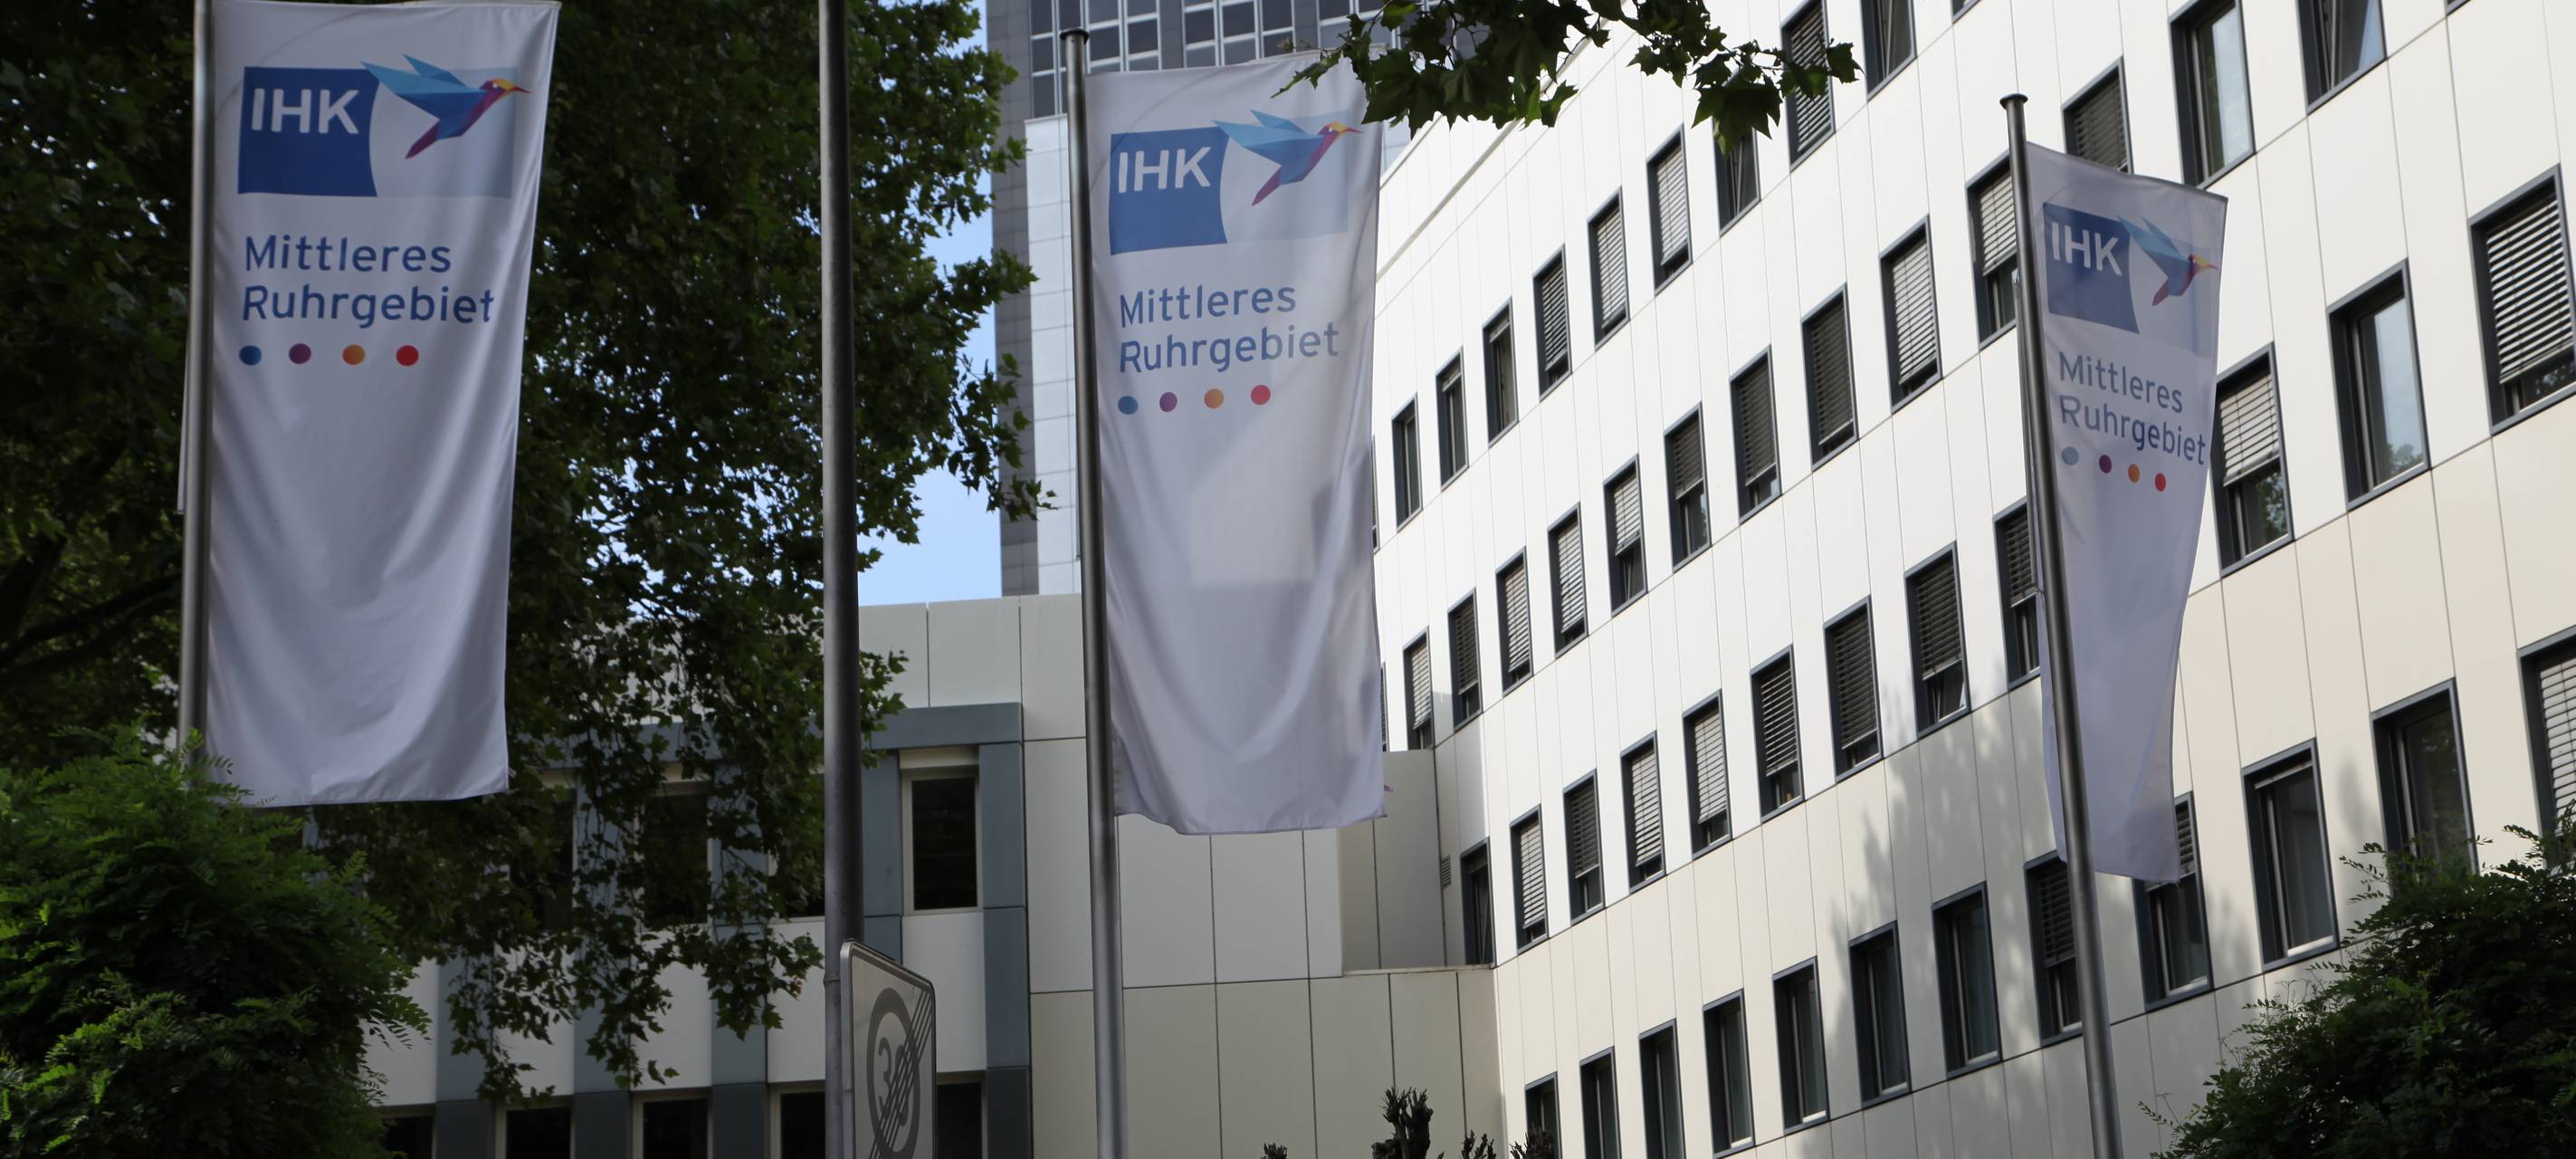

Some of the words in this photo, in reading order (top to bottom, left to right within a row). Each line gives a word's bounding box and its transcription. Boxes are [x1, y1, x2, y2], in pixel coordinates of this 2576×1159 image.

[251, 88, 359, 135] IHK
[1118, 146, 1211, 194] IHK
[244, 235, 452, 273] Mittleres
[2051, 221, 2123, 276] IHK
[242, 283, 495, 329] Ruhrgebiet
[1119, 284, 1297, 329] Mittleres
[1119, 321, 1340, 374] Ruhrgebiet
[2058, 350, 2183, 413] Mittleres
[2058, 394, 2206, 466] Ruhrgebiet
